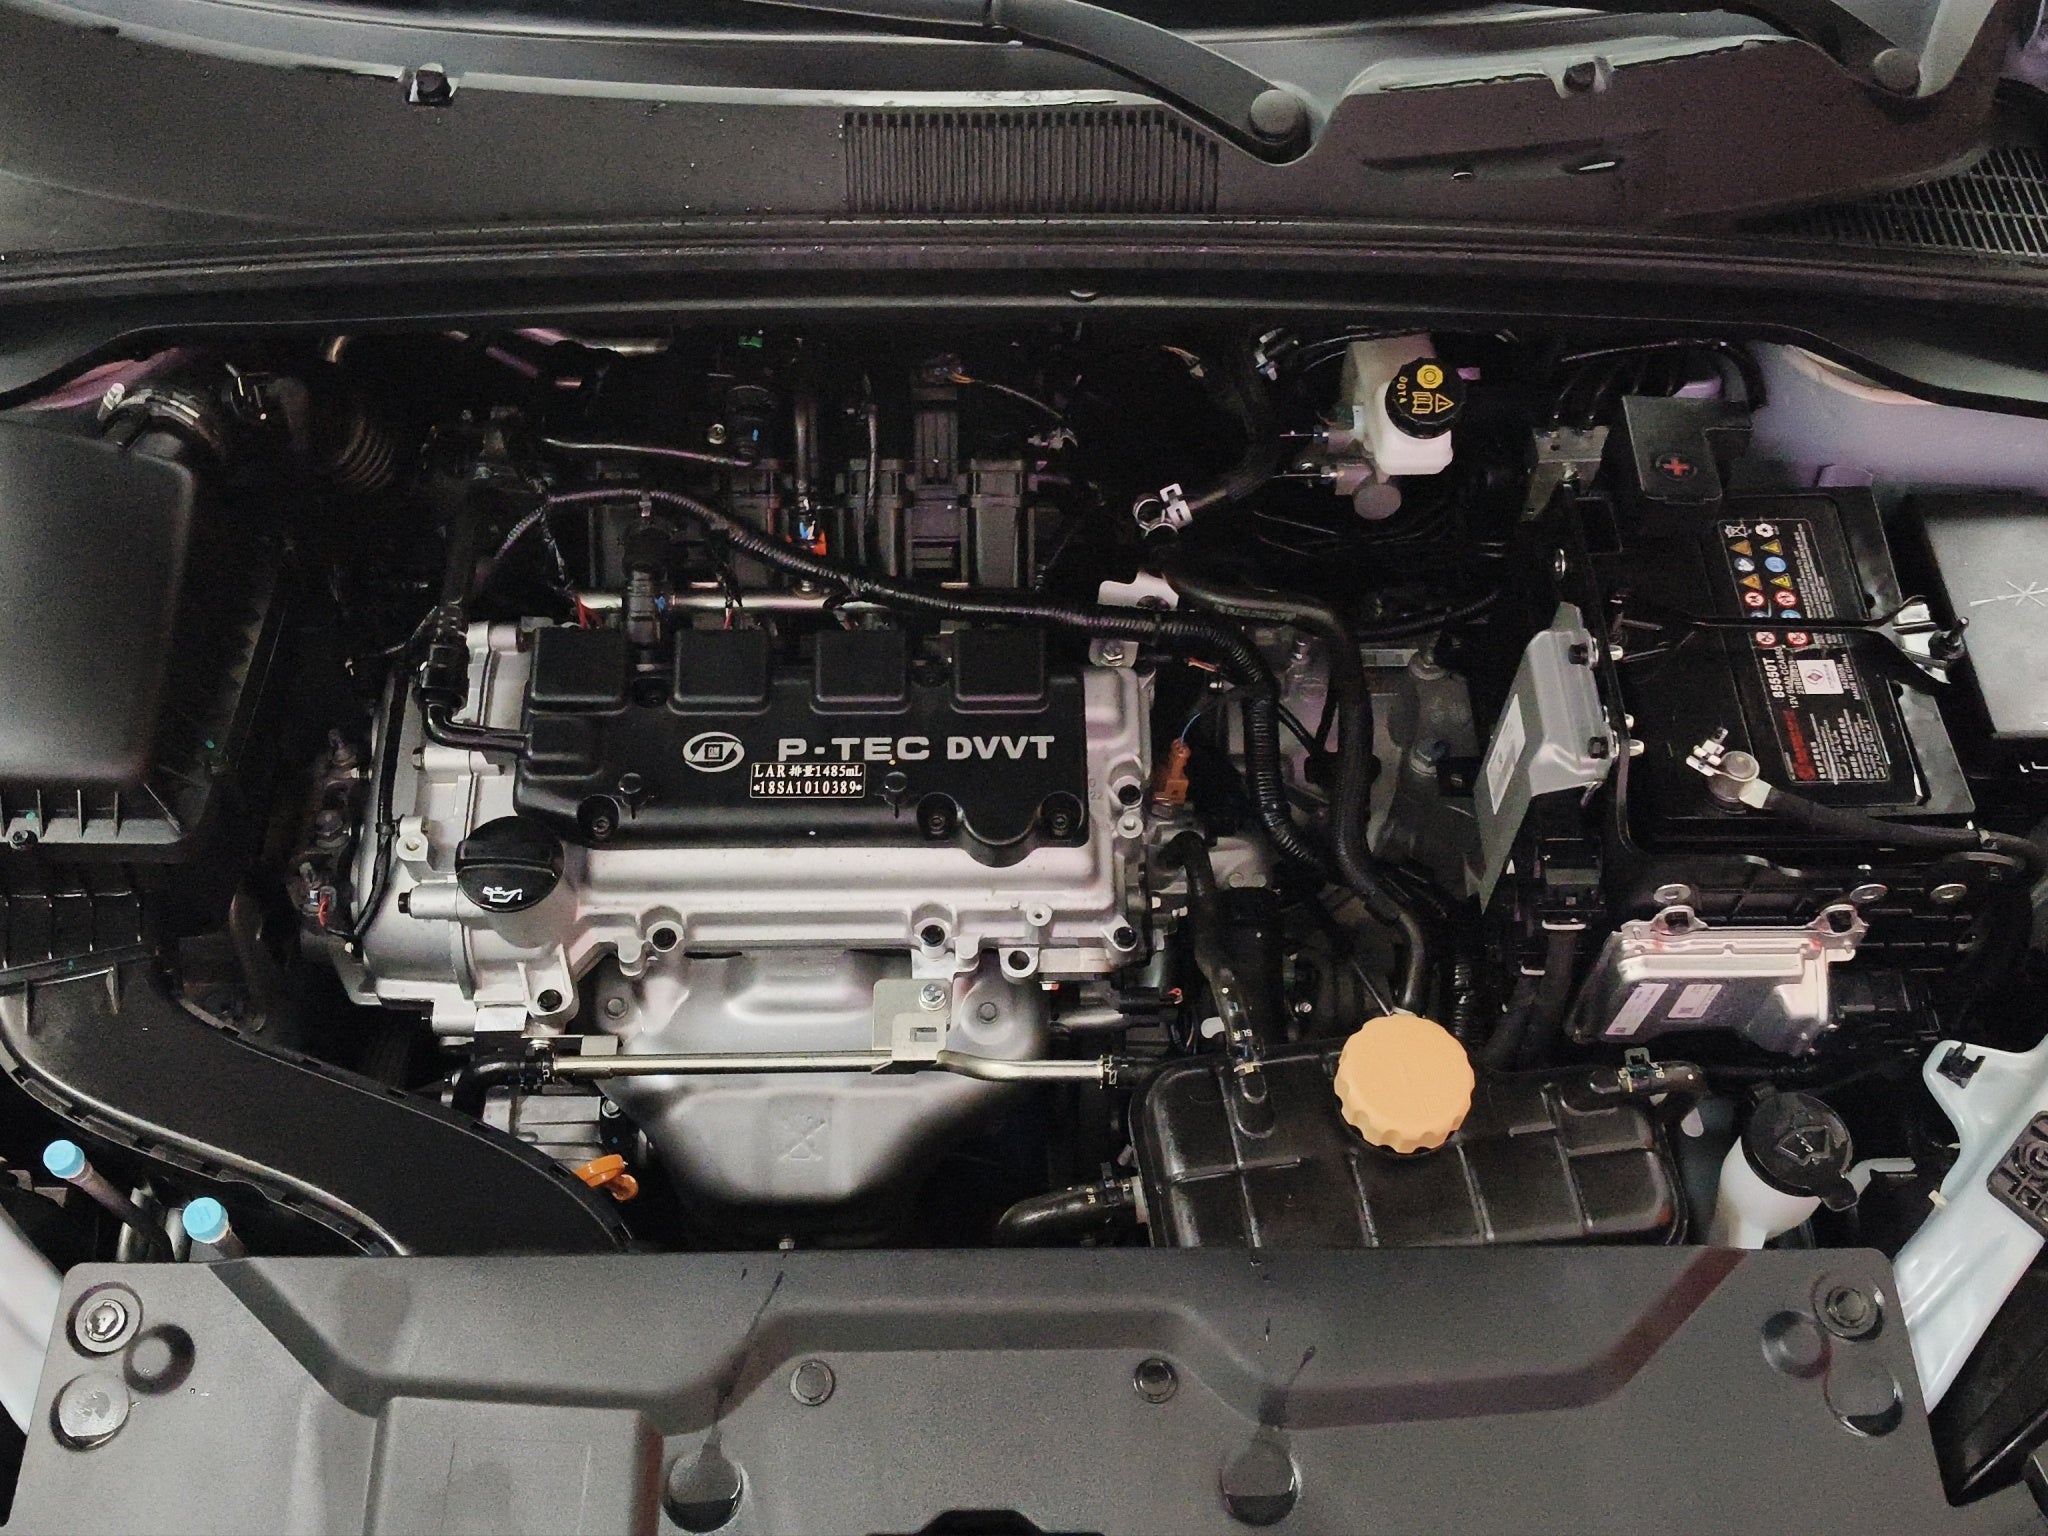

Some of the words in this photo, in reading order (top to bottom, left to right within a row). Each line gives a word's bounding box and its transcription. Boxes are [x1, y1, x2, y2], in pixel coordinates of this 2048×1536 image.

[1841, 653, 1853, 674] CHINA
[1849, 681, 1861, 700] MADE
[778, 736, 931, 762] P-TEC
[947, 735, 1055, 760] DVVT
[754, 764, 786, 778] LAR
